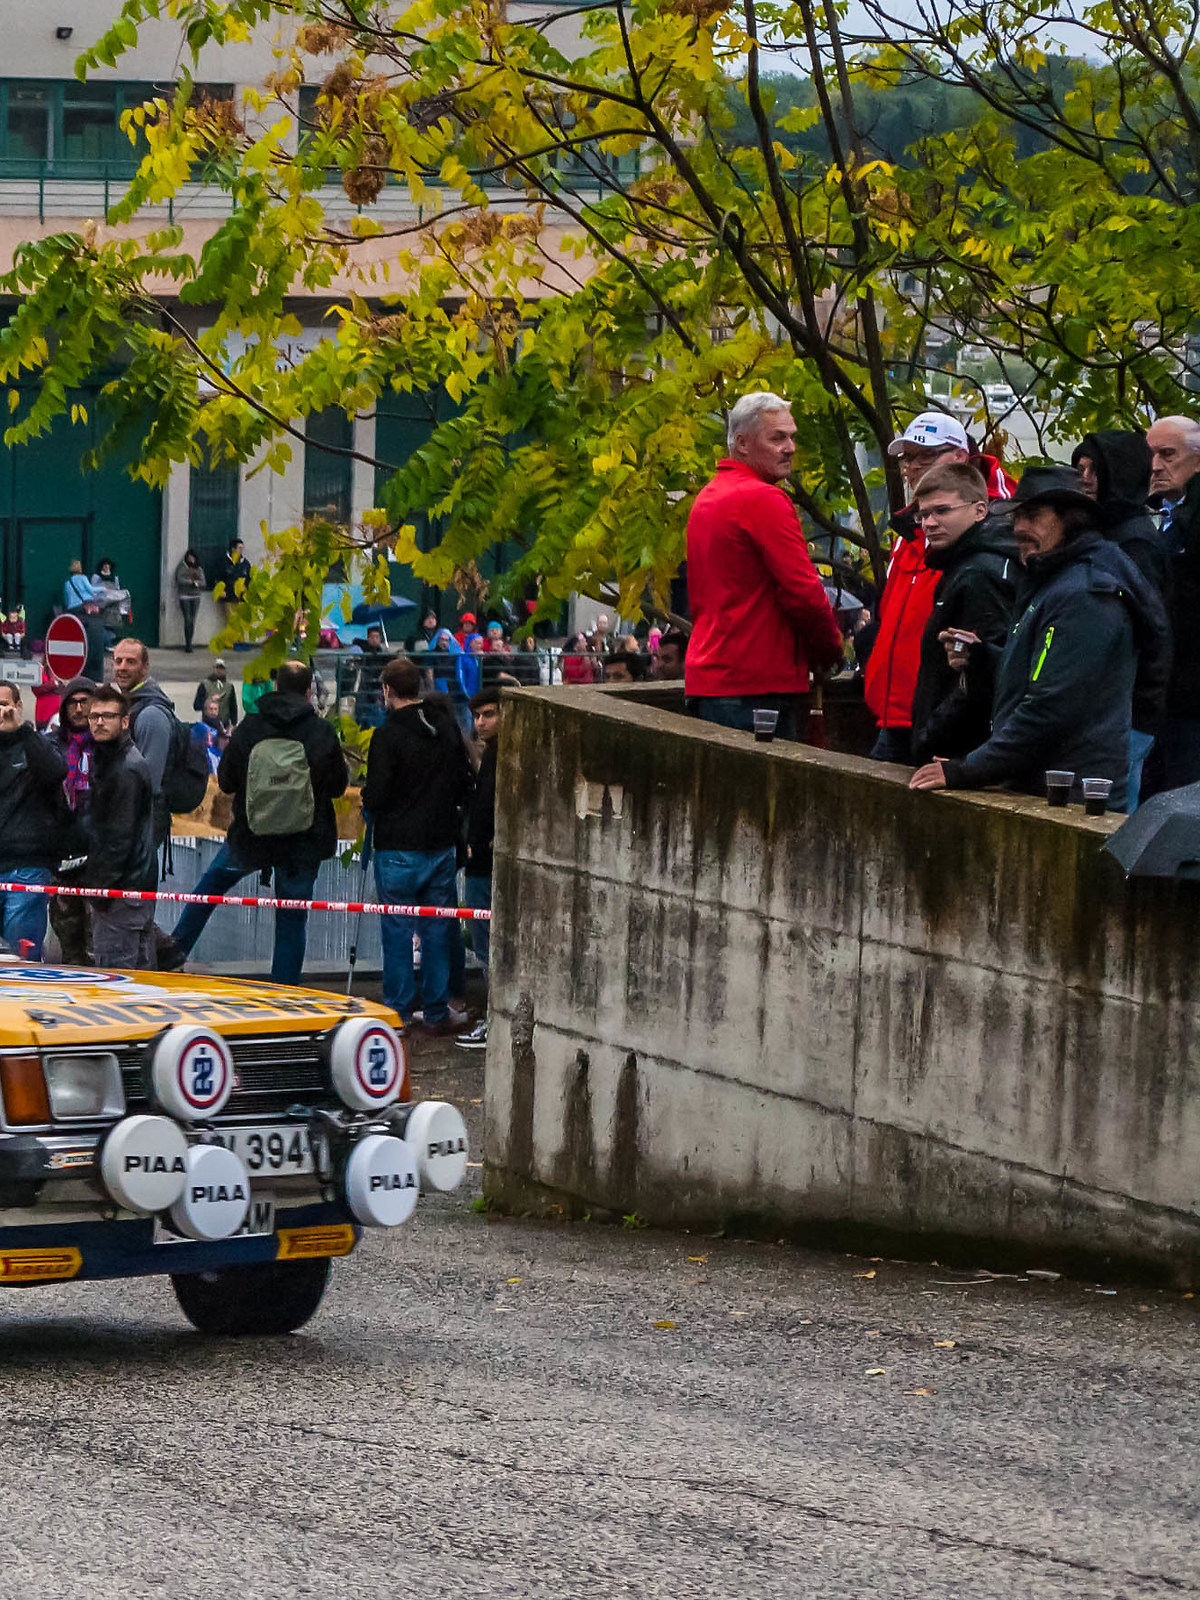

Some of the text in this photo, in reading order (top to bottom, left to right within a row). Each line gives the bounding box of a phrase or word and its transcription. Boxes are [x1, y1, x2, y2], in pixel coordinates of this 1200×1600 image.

[25, 997, 366, 1029] ANDREWS
[427, 1137, 465, 1160] PIAA
[124, 1156, 186, 1173] PIAA
[369, 1172, 416, 1193] PIAA
[192, 1184, 246, 1203] PIAA
